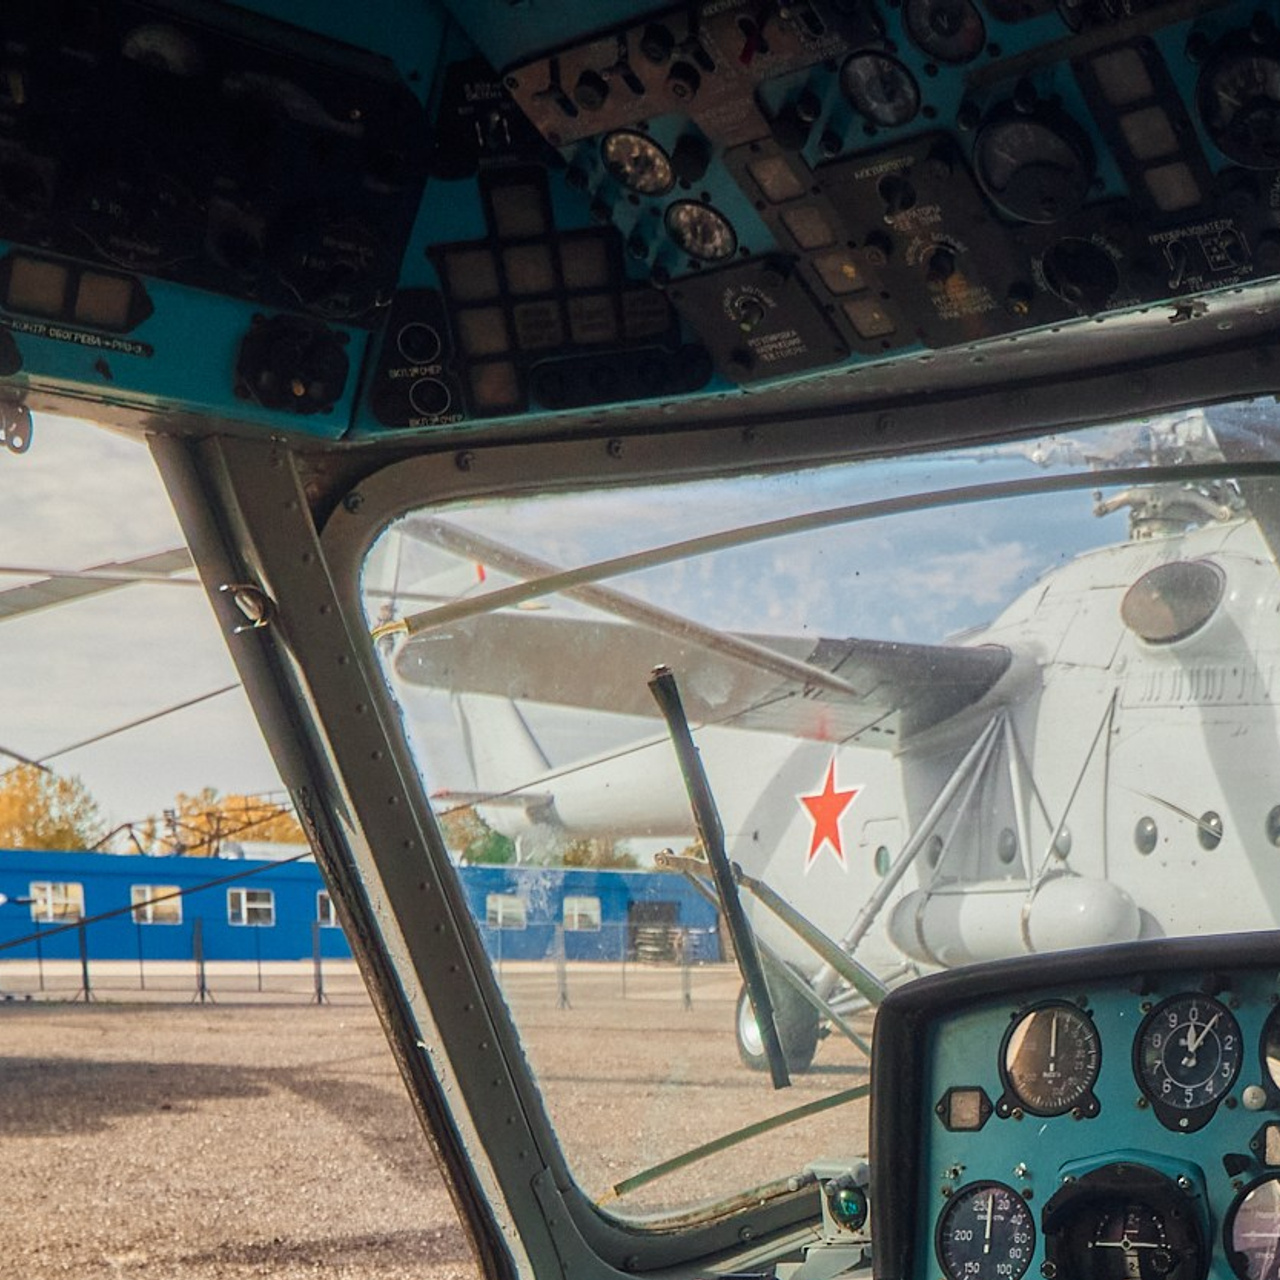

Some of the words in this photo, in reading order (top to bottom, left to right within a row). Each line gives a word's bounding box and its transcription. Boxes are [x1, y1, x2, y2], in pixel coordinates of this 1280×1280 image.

[1169, 1013, 1178, 1028] 9
[1189, 1007, 1198, 1021] 0
[1153, 1034, 1161, 1048] 8
[1224, 1035, 1233, 1050] 2
[1153, 1060, 1162, 1075] 7
[1221, 1062, 1231, 1078] 3
[1162, 1079, 1172, 1093] 6
[1205, 1080, 1214, 1093] 4
[1184, 1088, 1194, 1103] 5
[997, 1200, 1010, 1210] 20
[1010, 1215, 1023, 1225] 40
[954, 1230, 972, 1241] 200
[1014, 1233, 1027, 1244] 60
[1009, 1248, 1021, 1259] 80
[964, 1262, 980, 1274] 150
[997, 1264, 1012, 1275] 100
